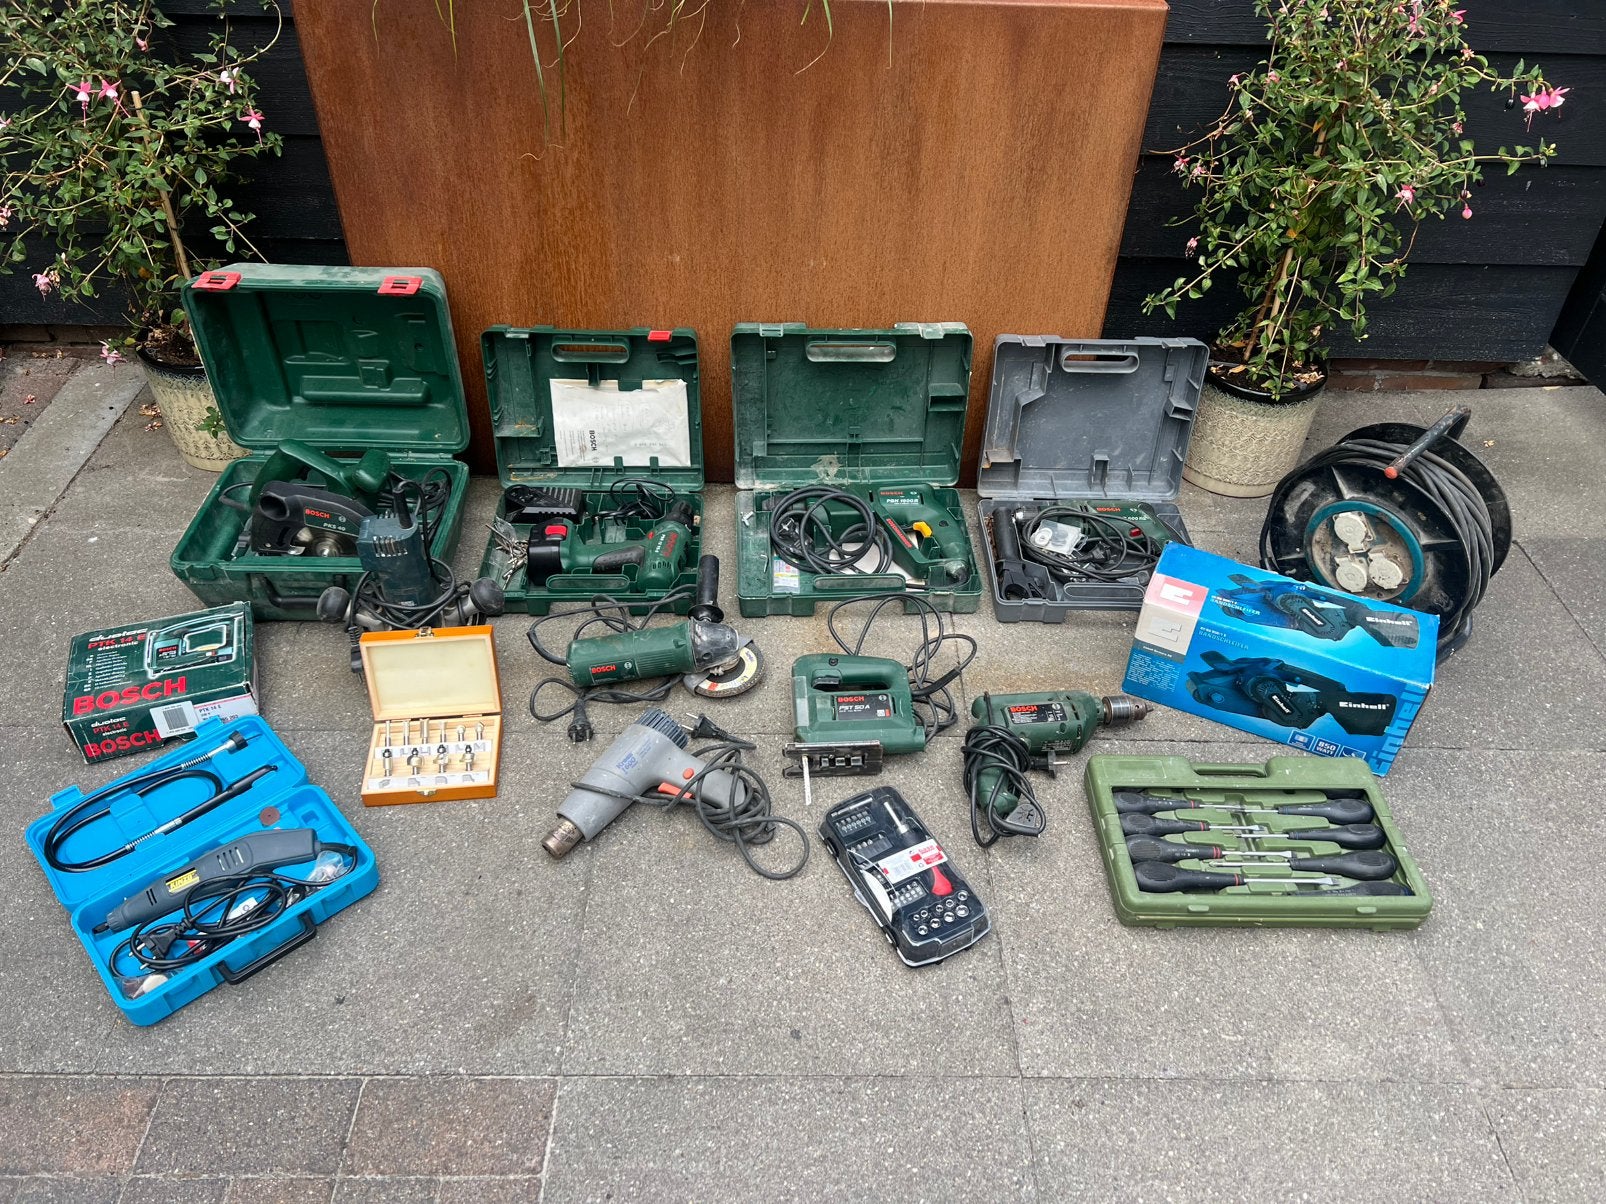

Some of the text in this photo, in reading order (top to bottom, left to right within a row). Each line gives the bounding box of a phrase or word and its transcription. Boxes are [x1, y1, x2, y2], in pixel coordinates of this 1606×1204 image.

[589, 430, 597, 451] BOSCH
[305, 508, 330, 518] BOSCH
[1366, 616, 1411, 626] Einhell
[88, 639, 116, 649] PTK
[98, 641, 138, 651] electronic
[592, 665, 616, 674] BOSCH
[73, 676, 186, 716] BOSCH
[1272, 695, 1292, 714] Einhell
[1339, 701, 1386, 710] Einhell
[93, 725, 111, 734] PTK
[102, 728, 127, 736] electronic
[84, 729, 162, 758] BOSCH
[1318, 741, 1336, 751] 850
[1316, 746, 1334, 755] WATT
